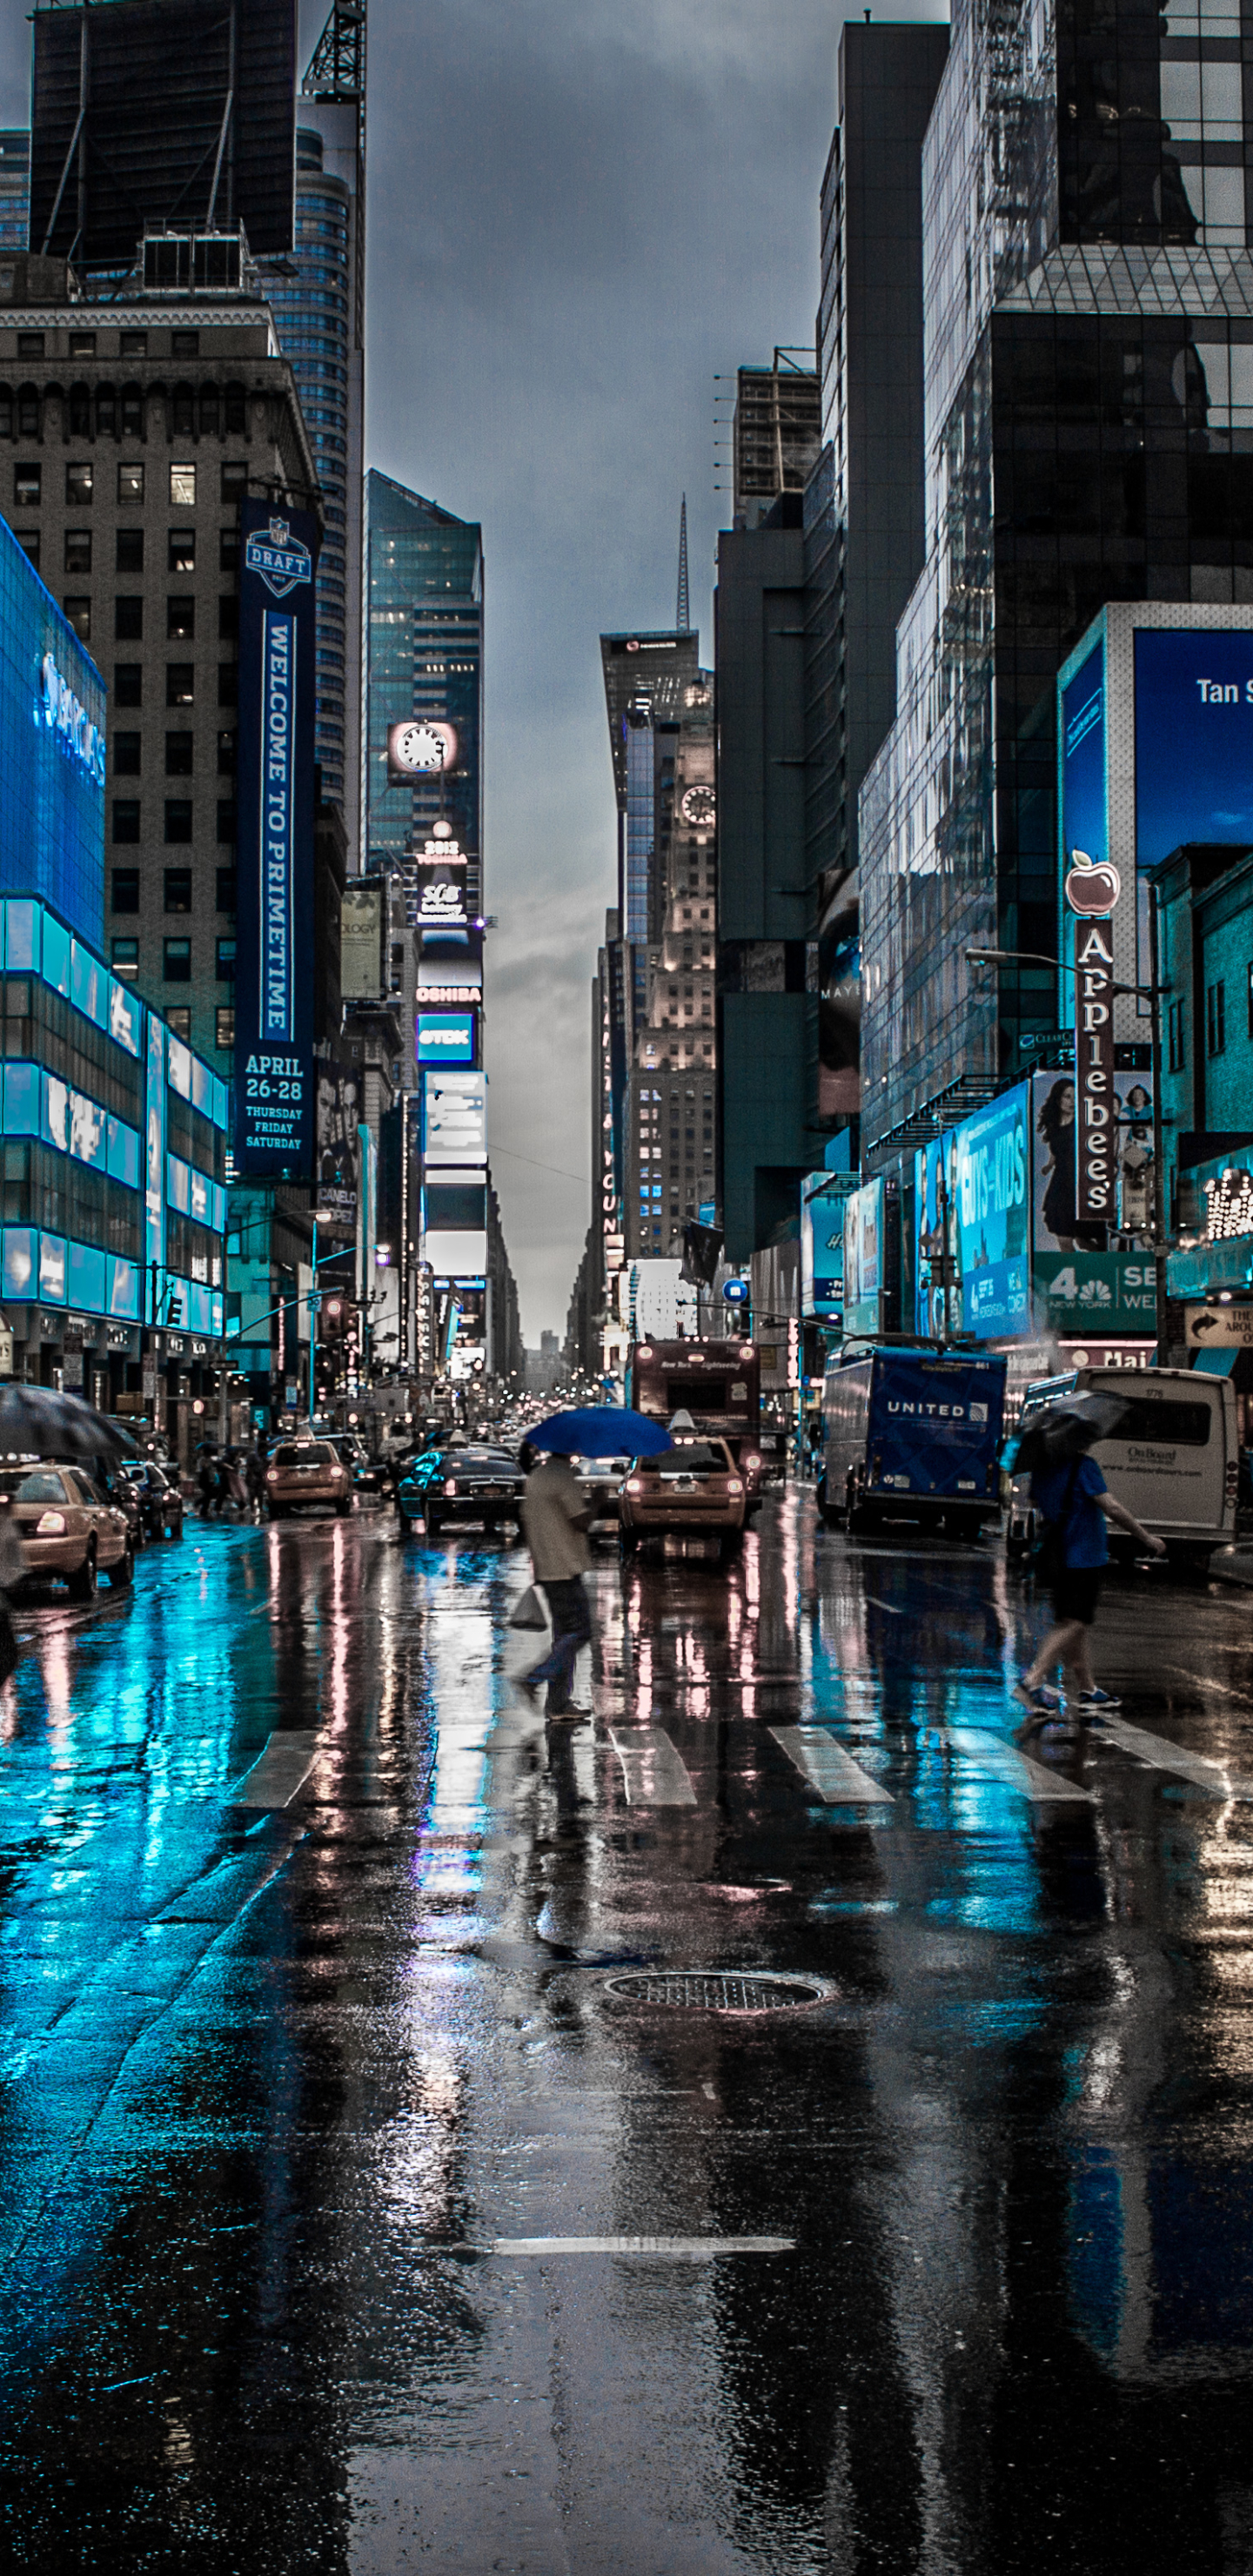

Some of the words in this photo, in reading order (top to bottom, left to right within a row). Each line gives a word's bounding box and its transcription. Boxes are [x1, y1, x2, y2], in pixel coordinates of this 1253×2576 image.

[251, 548, 305, 574] DRAFT
[1196, 679, 1239, 703] Tan
[267, 625, 289, 782] WELCOME
[268, 789, 286, 832] TO
[267, 842, 286, 1029] PRIMETIME
[245, 1054, 304, 1077] APRIL
[1077, 928, 1114, 1209] Applebee's
[246, 1078, 302, 1101] 26-28
[245, 1105, 303, 1120] THURSDAY
[255, 1121, 294, 1134] FRIDAY
[246, 1136, 302, 1150] SATURDAY
[325, 1207, 353, 1224] OPEZ
[1049, 1267, 1078, 1299] 4
[1078, 1300, 1112, 1309] YORK
[1123, 1294, 1157, 1309] WE
[888, 1401, 965, 1417] UNITED
